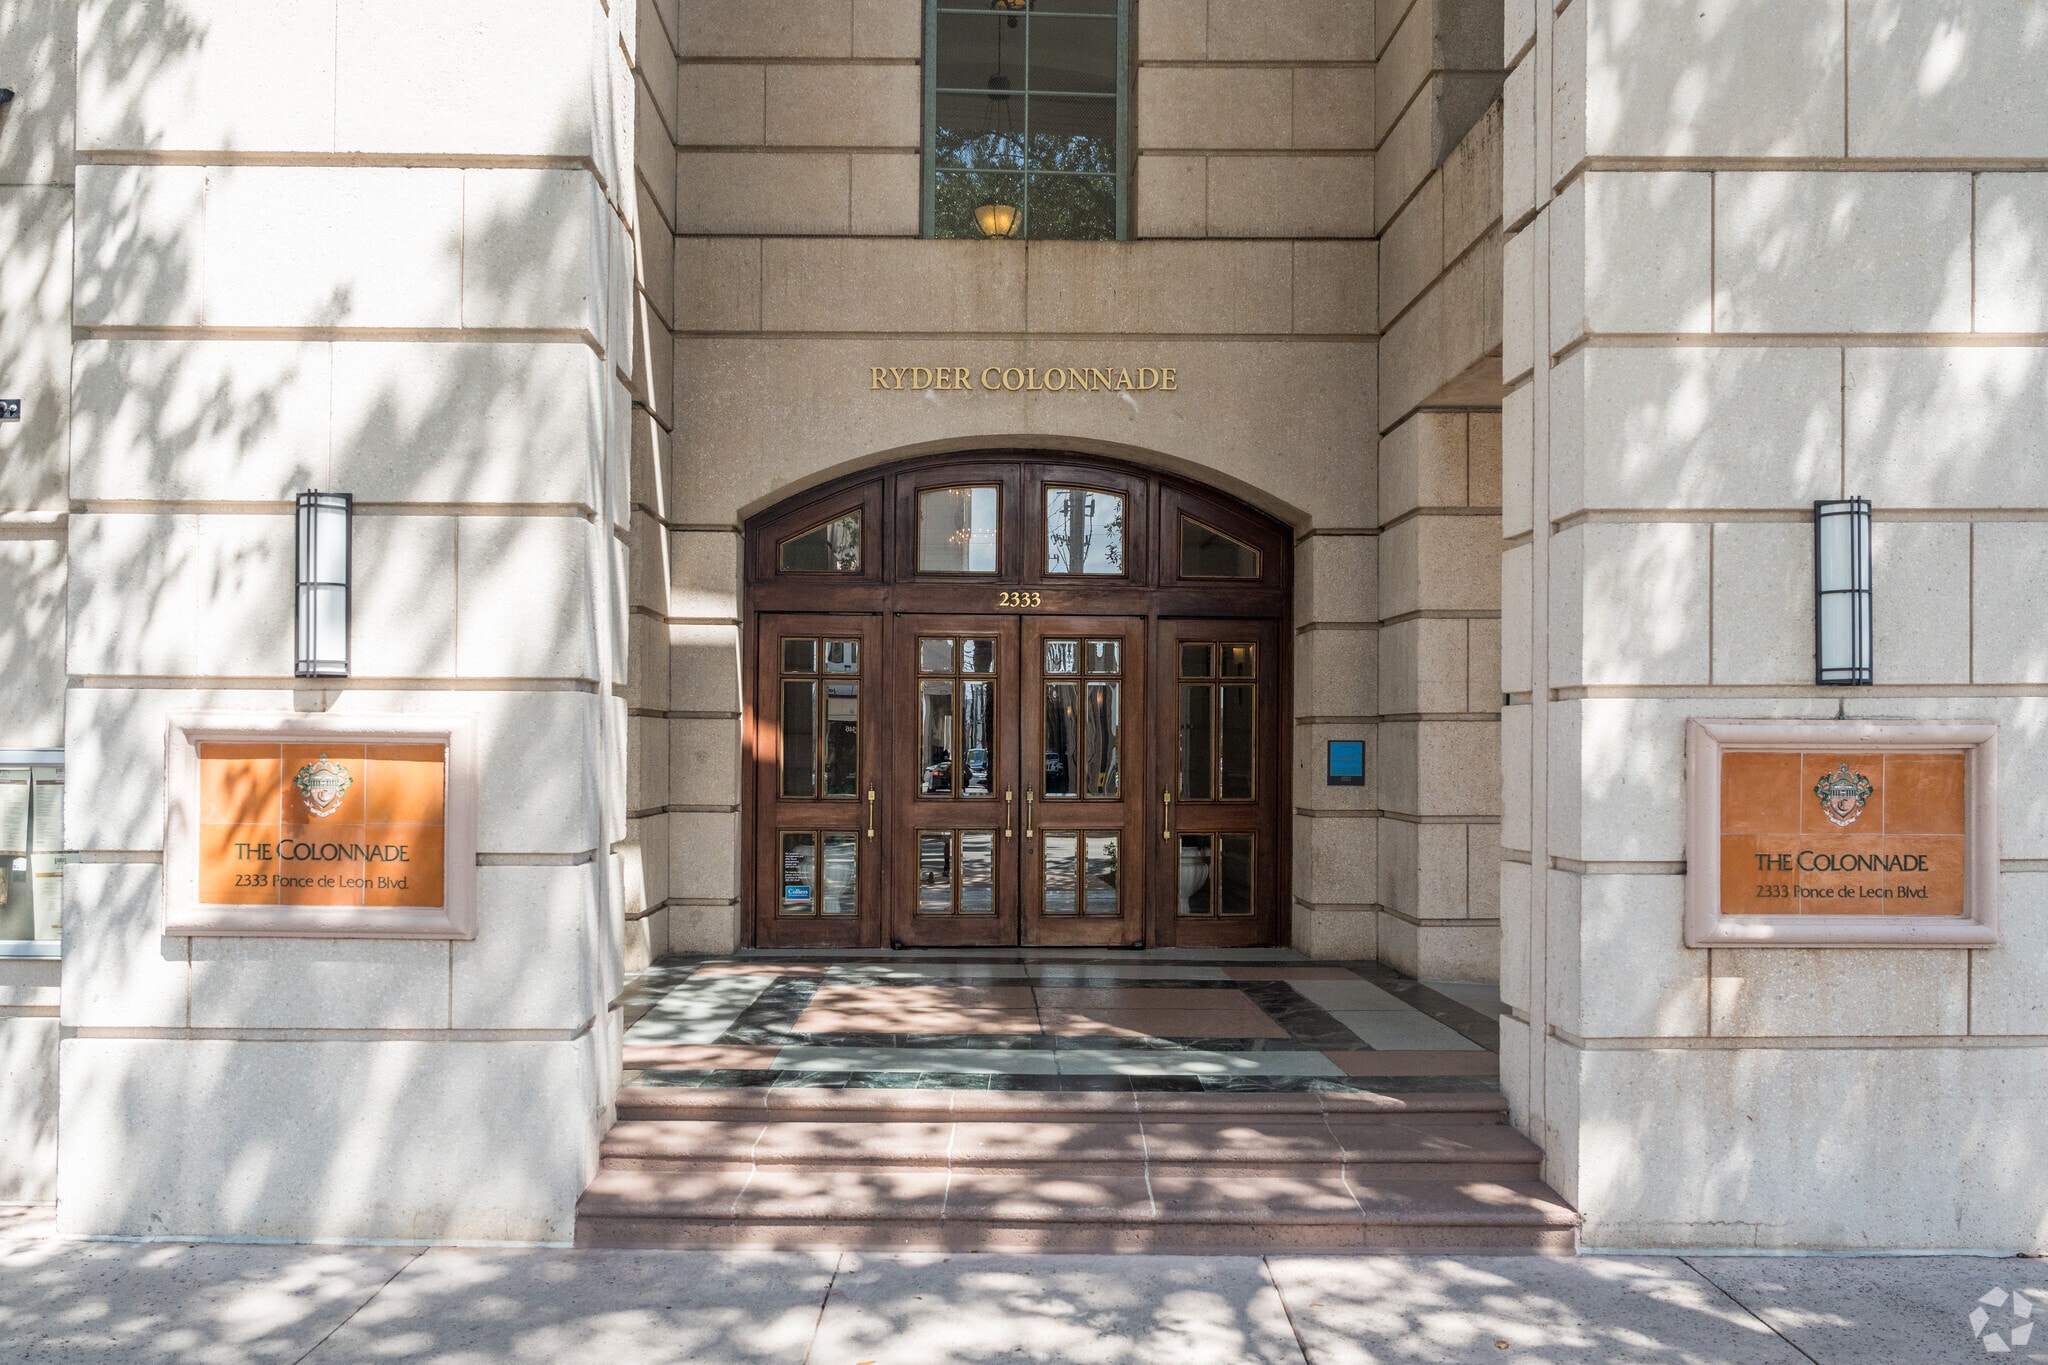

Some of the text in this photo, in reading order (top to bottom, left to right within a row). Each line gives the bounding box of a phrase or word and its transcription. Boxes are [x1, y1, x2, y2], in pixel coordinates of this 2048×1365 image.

[870, 366, 1178, 392] RYDER COLONNADE
[999, 591, 1041, 608] 2333
[234, 839, 410, 862] THE COLONNADE
[1755, 850, 1929, 872] THE COLONNADE
[234, 874, 410, 890] 2333 Ponce de Leon Blvd.
[1756, 885, 1929, 899] 2333 Ponce de Leon Blvd.
